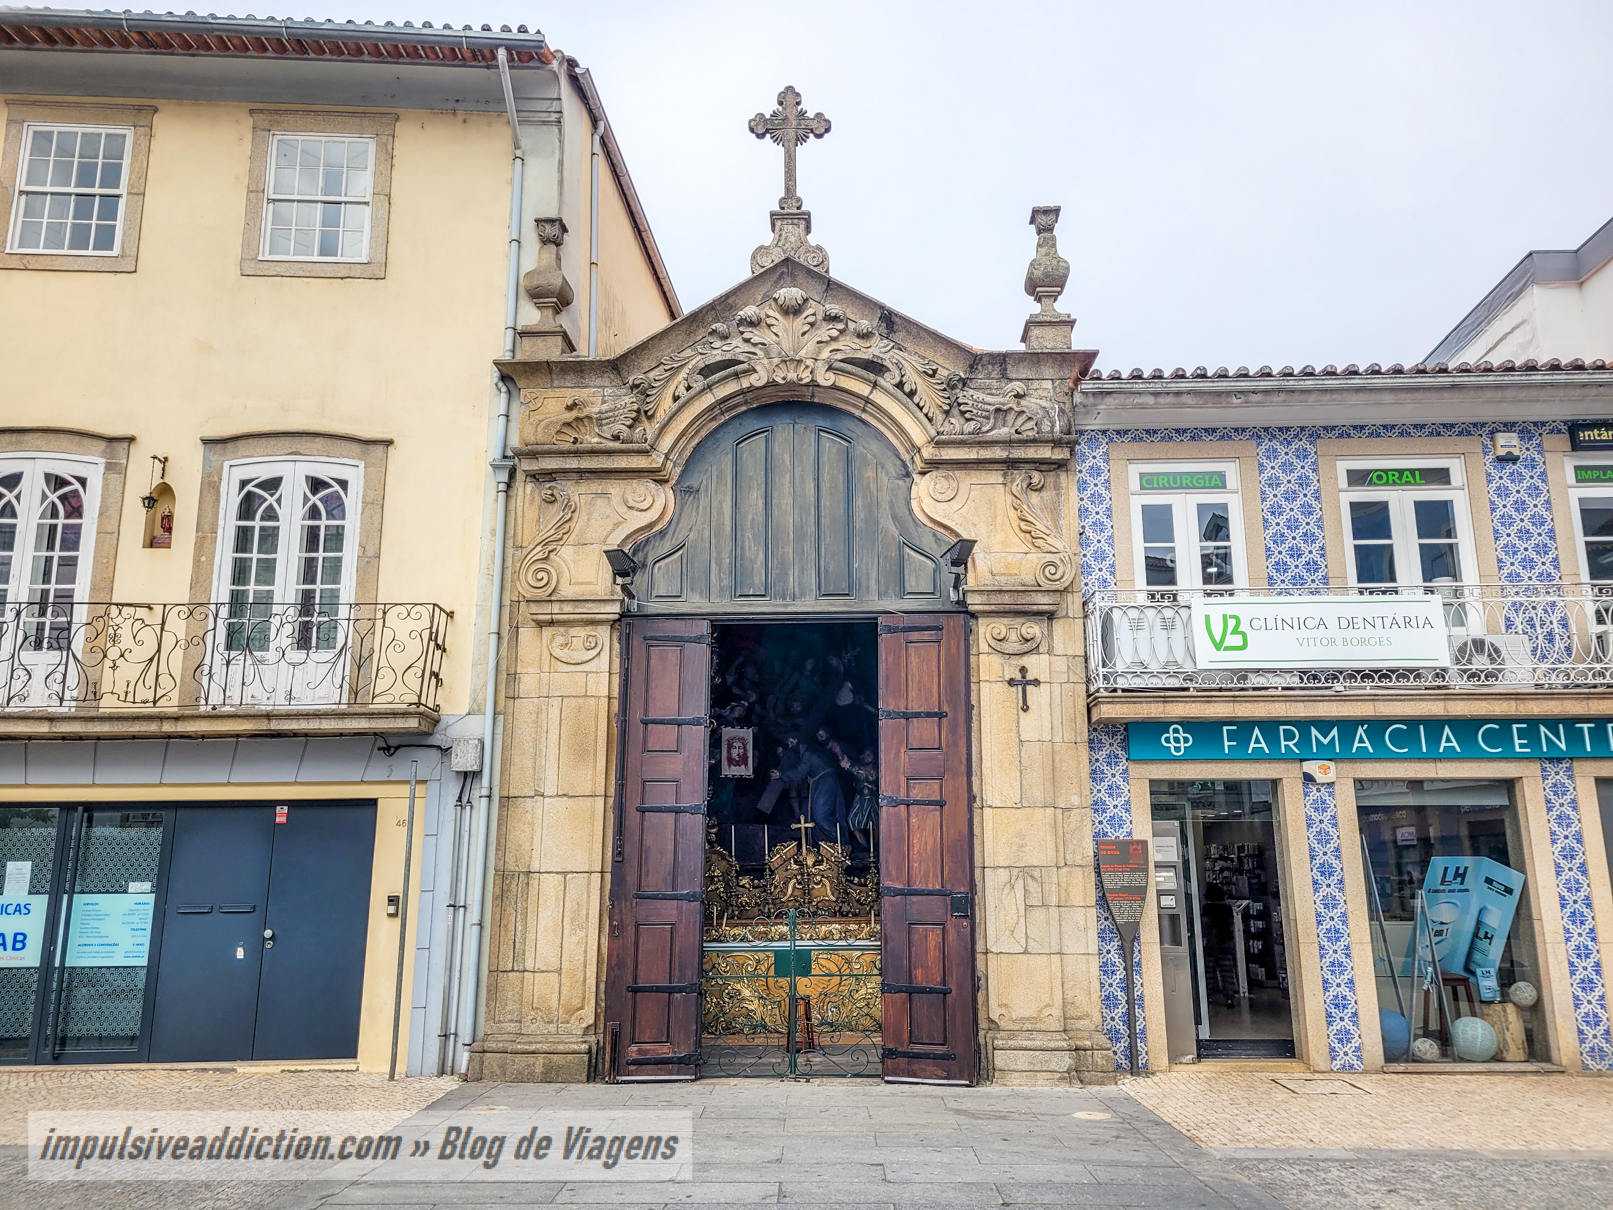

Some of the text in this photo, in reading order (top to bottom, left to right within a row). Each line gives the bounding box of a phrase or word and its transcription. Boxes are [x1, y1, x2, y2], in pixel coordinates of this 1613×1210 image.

[1142, 474, 1222, 488] CIRURGIA
[1372, 470, 1426, 484] ORAL
[1250, 612, 1435, 631] CLÍNICA DENTÁRIA
[1204, 613, 1249, 651] VB
[1296, 636, 1393, 647] VITOR BORGES
[1222, 723, 1461, 754] FARMÁCIA
[395, 818, 407, 828] 46
[1439, 866, 1469, 886] LH
[1475, 926, 1495, 946] LH
